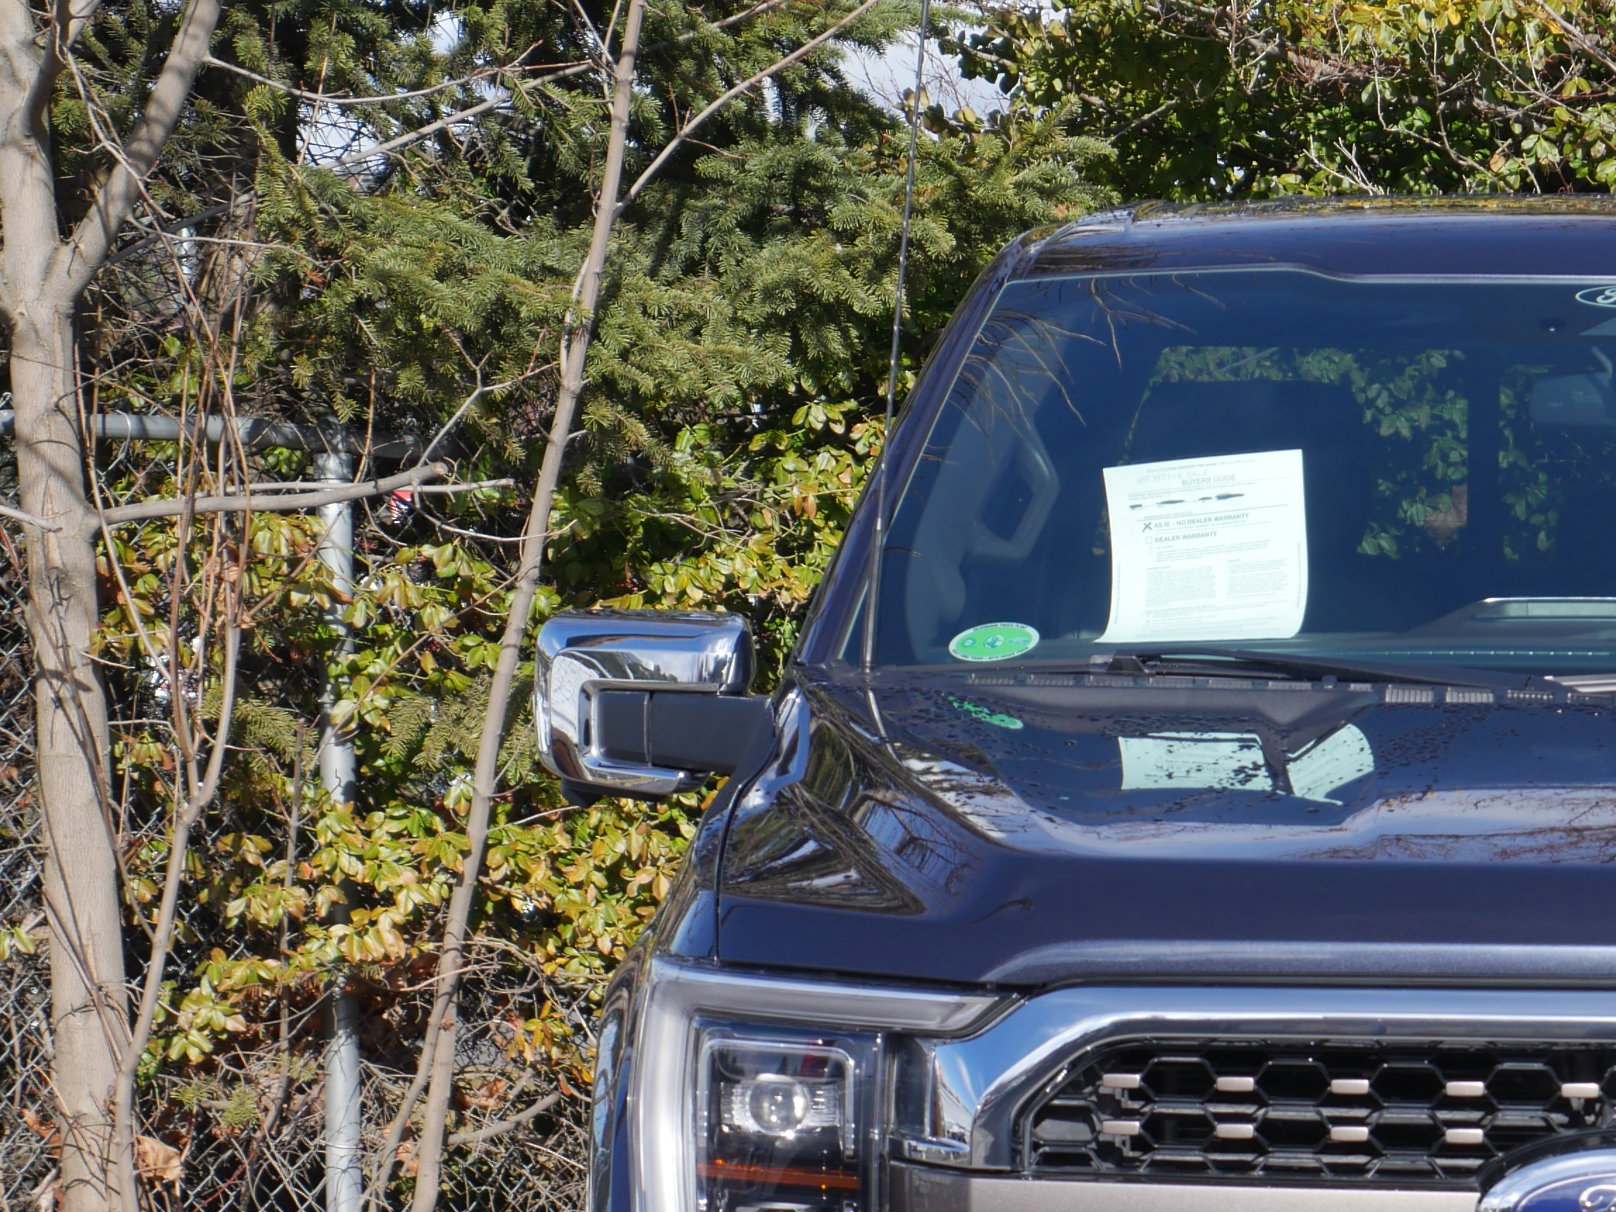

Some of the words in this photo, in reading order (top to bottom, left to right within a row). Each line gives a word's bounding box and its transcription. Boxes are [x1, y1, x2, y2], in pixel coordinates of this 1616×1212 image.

[1181, 475, 1212, 487] BUYERS
[1213, 473, 1237, 484] GUIDE
[1187, 516, 1213, 525] DEALER
[1213, 513, 1249, 522] WARRANTY
[1154, 534, 1180, 543] DEALER
[1181, 531, 1218, 540] WARRANTY
